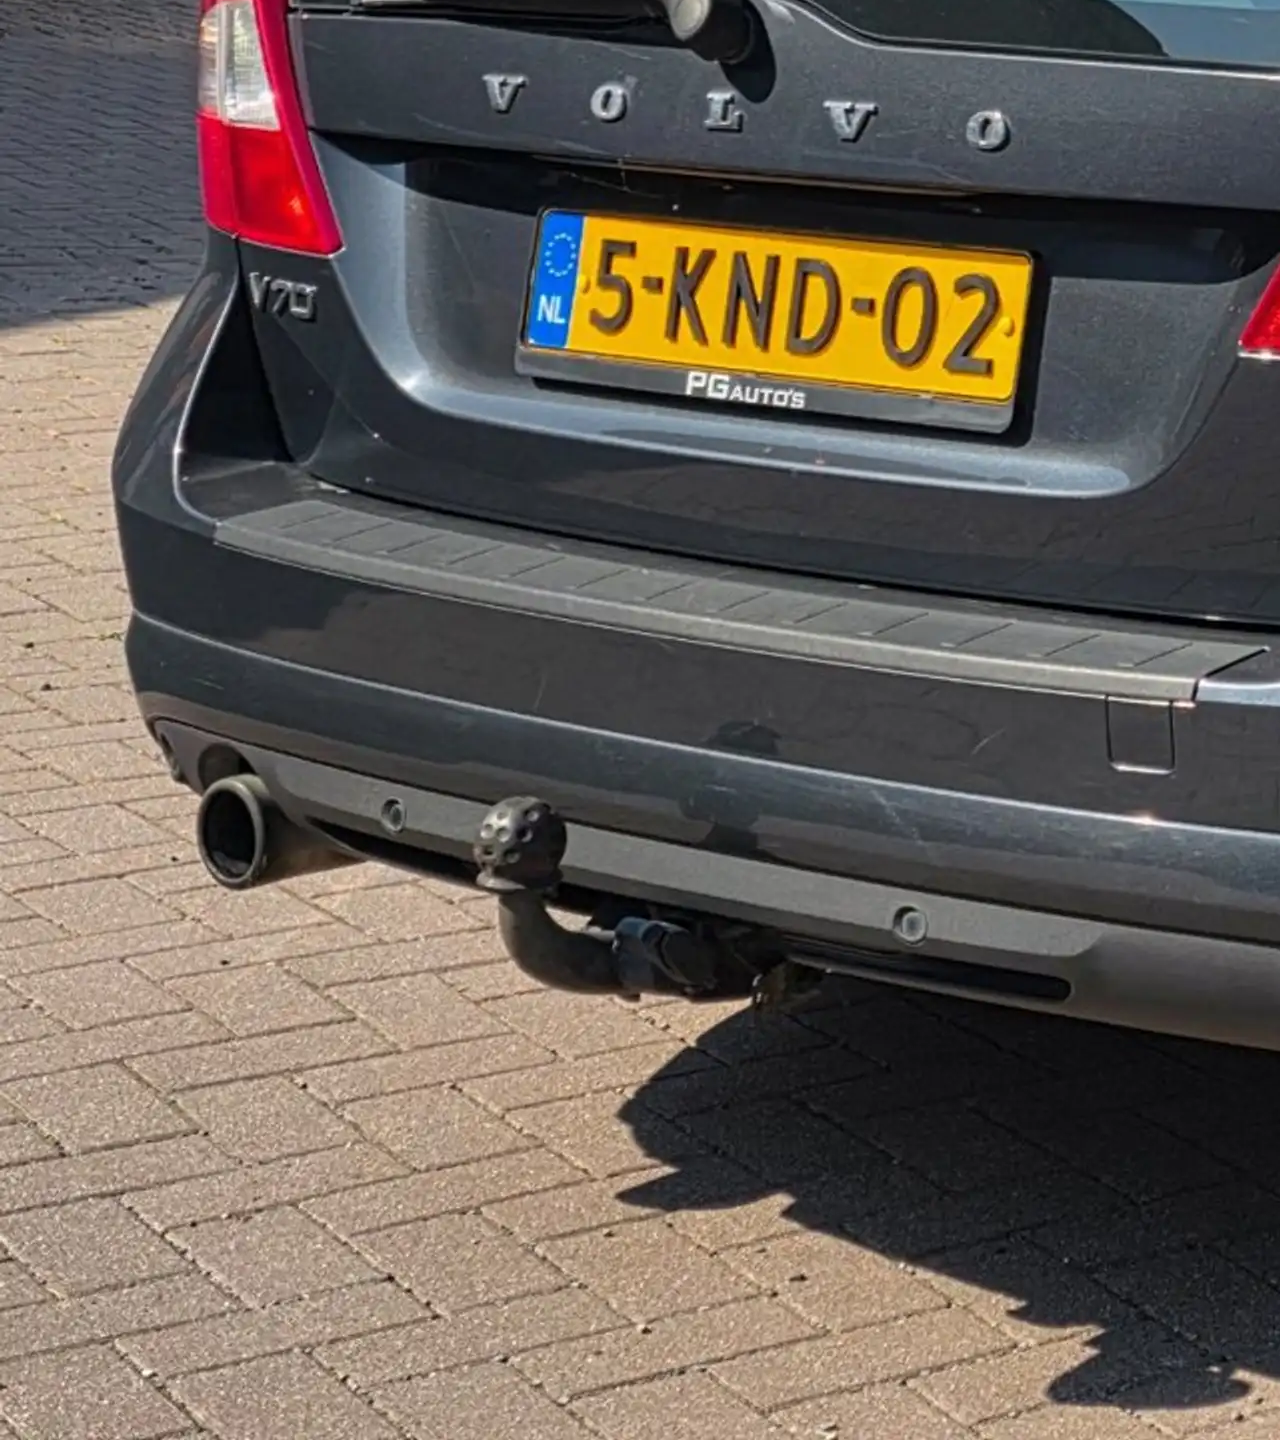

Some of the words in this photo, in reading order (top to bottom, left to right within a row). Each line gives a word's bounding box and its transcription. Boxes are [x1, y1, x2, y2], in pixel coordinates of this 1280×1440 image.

[482, 73, 1010, 152] VOLVO
[249, 271, 317, 320] V70
[536, 293, 566, 326] NL
[588, 238, 1002, 381] 5-KND-02
